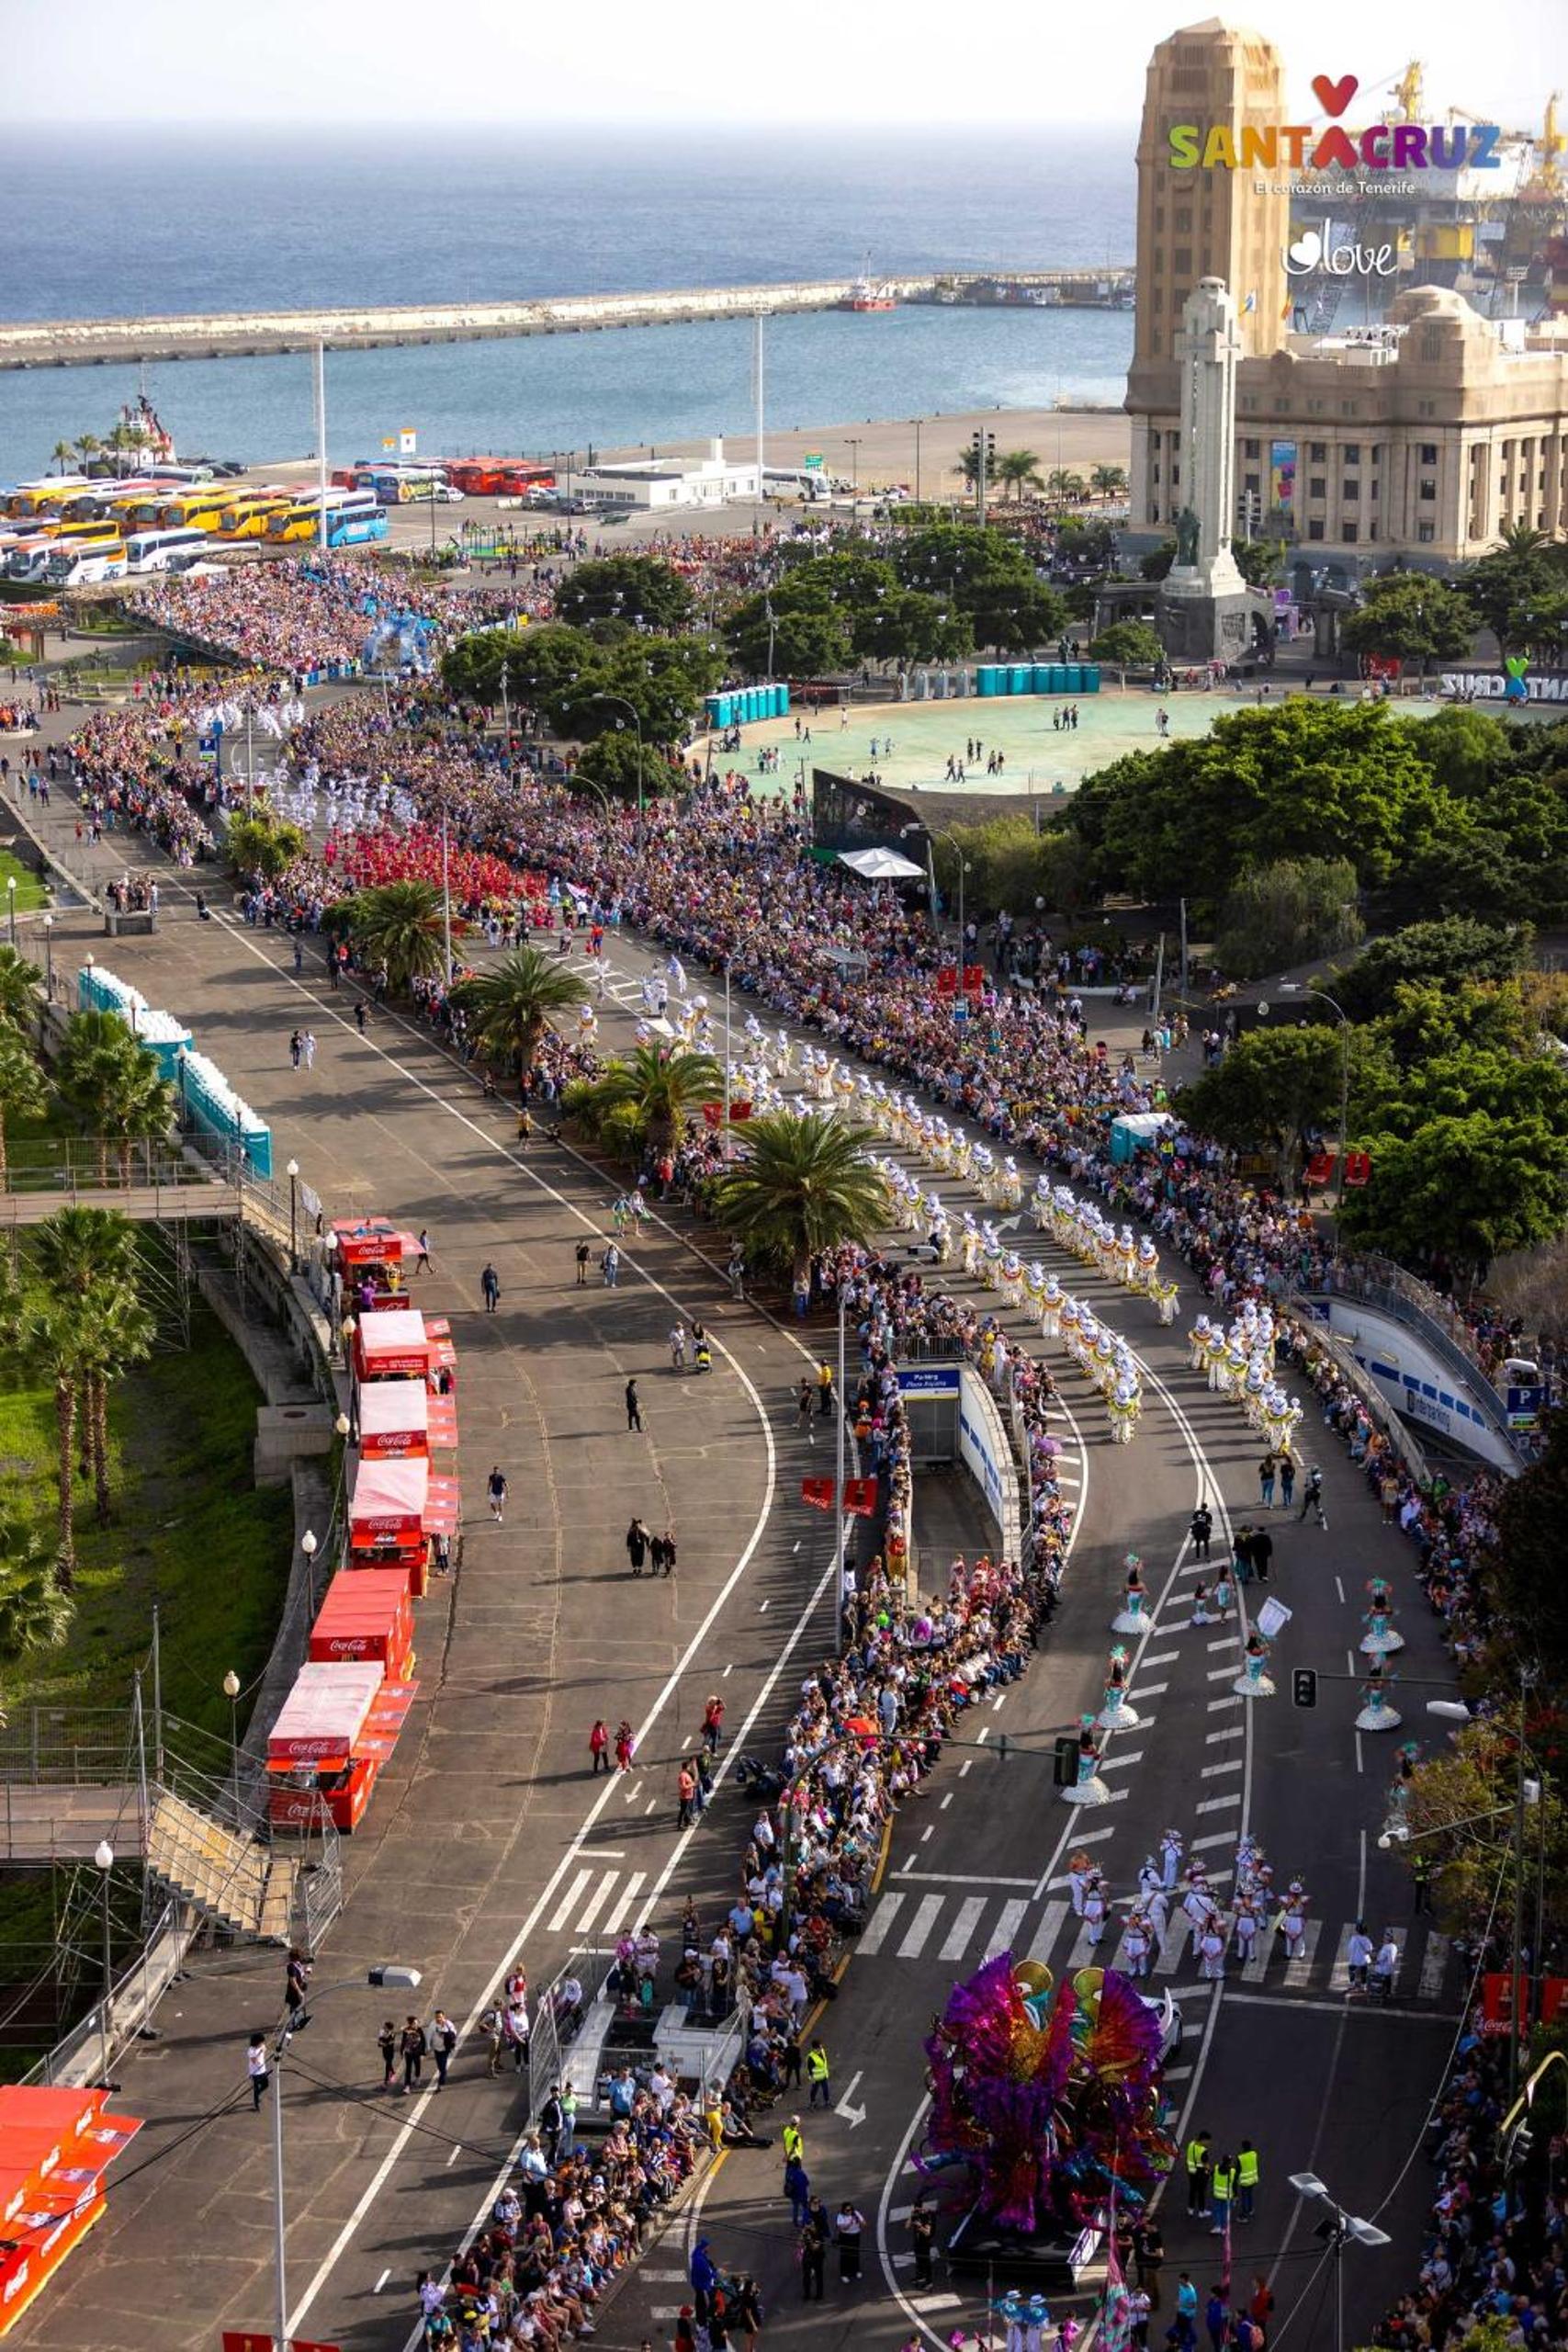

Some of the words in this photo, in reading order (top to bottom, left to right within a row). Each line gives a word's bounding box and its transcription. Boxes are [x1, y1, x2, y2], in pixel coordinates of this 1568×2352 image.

[1520, 1390, 1531, 1404] P
[330, 1639, 367, 1652] Coca-Cola
[288, 1742, 330, 1754] Coca-Cola
